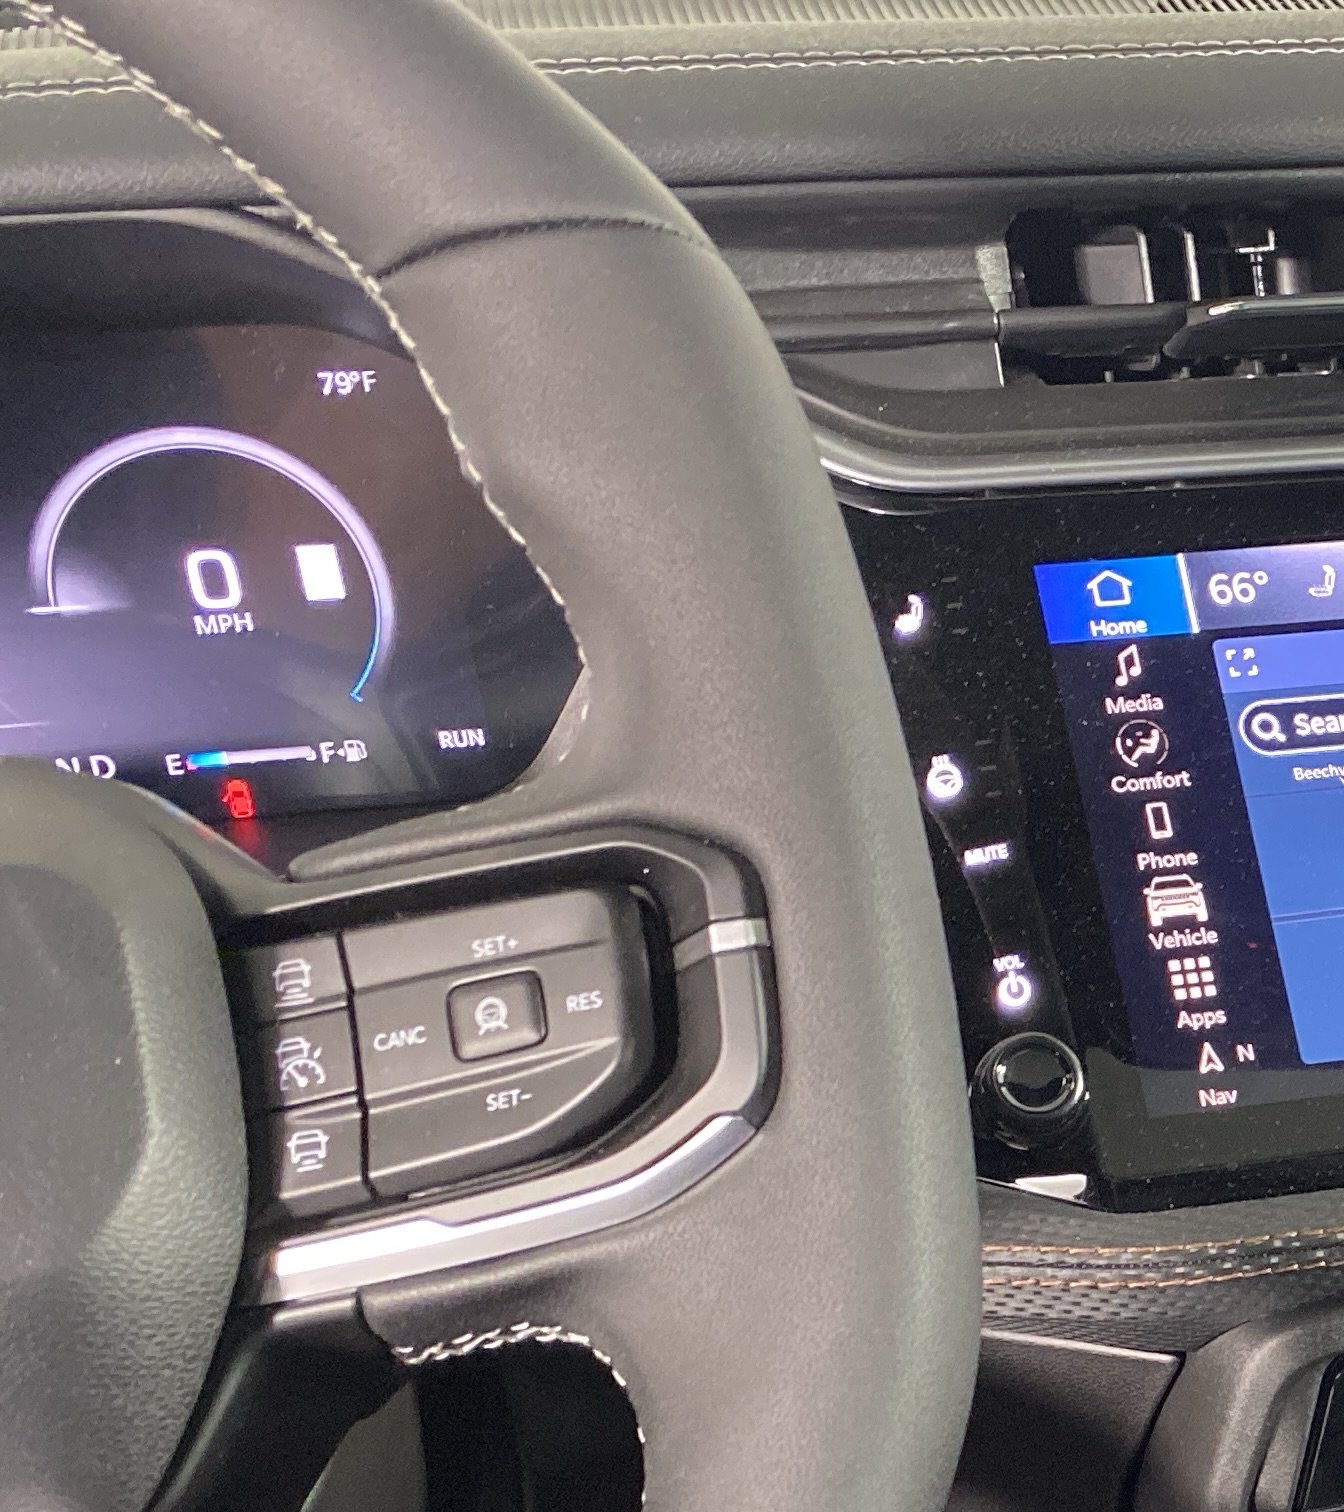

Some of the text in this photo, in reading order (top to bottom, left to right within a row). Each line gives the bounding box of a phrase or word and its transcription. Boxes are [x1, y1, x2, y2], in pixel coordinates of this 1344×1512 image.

[185, 549, 242, 610] 0
[1208, 571, 1269, 606] 66°
[194, 613, 254, 636] MPH
[1090, 619, 1148, 637] Home
[1105, 694, 1164, 715] Media
[438, 728, 486, 751] RUN
[318, 741, 336, 763] F
[89, 754, 116, 779] D
[165, 753, 185, 776] E
[1110, 770, 1192, 794] Comfort
[963, 843, 1009, 867] MUTE
[1137, 851, 1198, 872] Phone
[472, 935, 520, 958] SET+
[1149, 928, 1219, 951] Vehicle
[993, 954, 1025, 973] VOL
[566, 989, 603, 1014] RES
[1177, 1009, 1227, 1031] Apps
[373, 1025, 427, 1053] CANC
[1236, 1042, 1255, 1063] N
[1198, 1087, 1238, 1108] Nav
